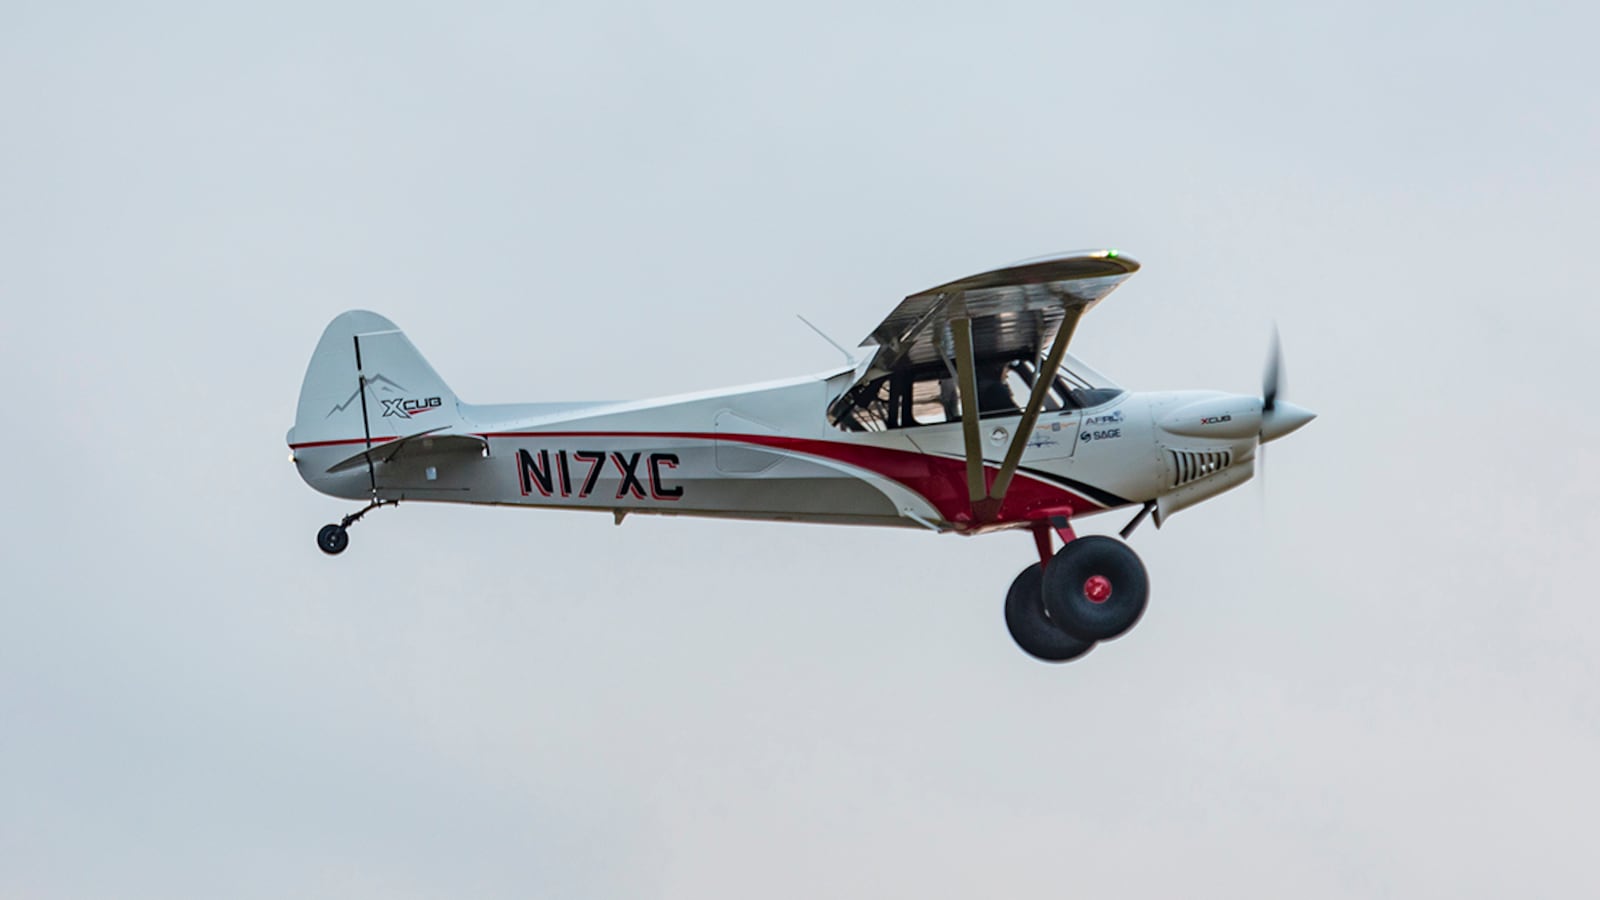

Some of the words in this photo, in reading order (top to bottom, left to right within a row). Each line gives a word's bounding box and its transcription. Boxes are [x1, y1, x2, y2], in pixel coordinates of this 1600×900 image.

[381, 396, 442, 418] XCUB
[1200, 415, 1232, 425] XCUB
[1093, 429, 1121, 440] SAGE
[516, 448, 684, 501] N17XC
